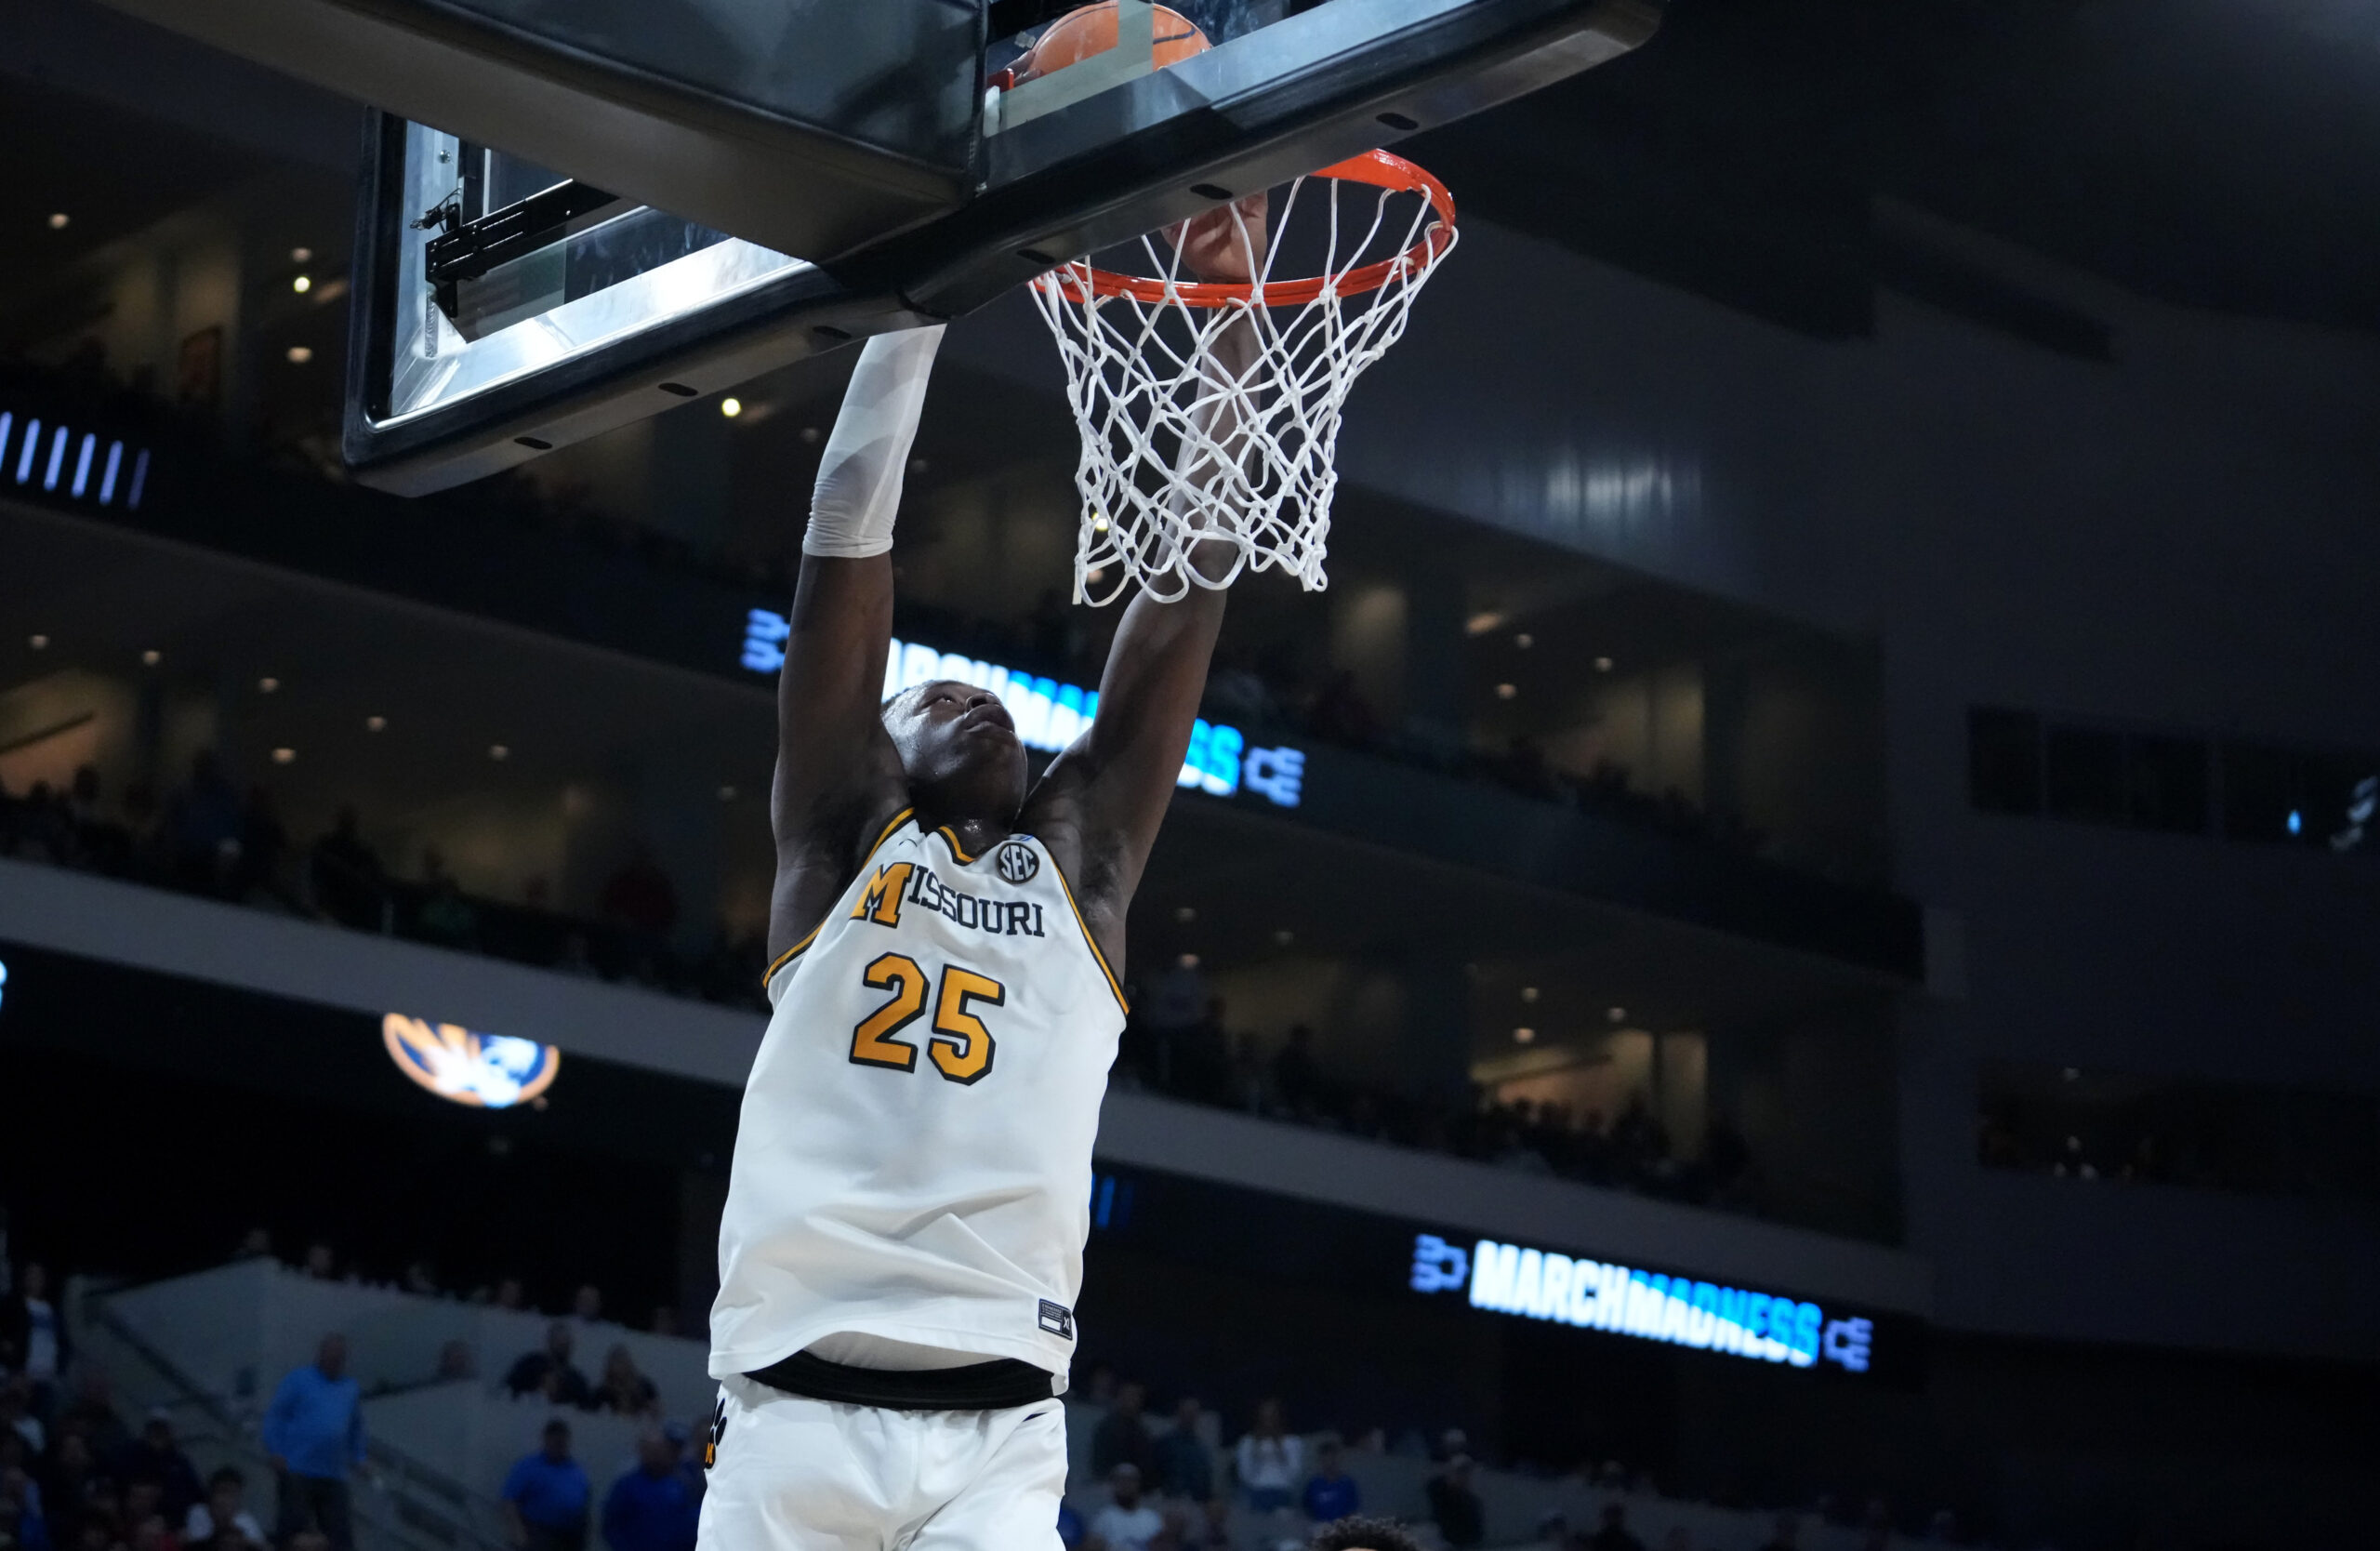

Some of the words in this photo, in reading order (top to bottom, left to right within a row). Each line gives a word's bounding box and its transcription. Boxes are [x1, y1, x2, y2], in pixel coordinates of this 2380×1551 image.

[850, 862, 1045, 937] MISSOURI
[999, 842, 1038, 882] SEC
[849, 951, 1005, 1086] 25
